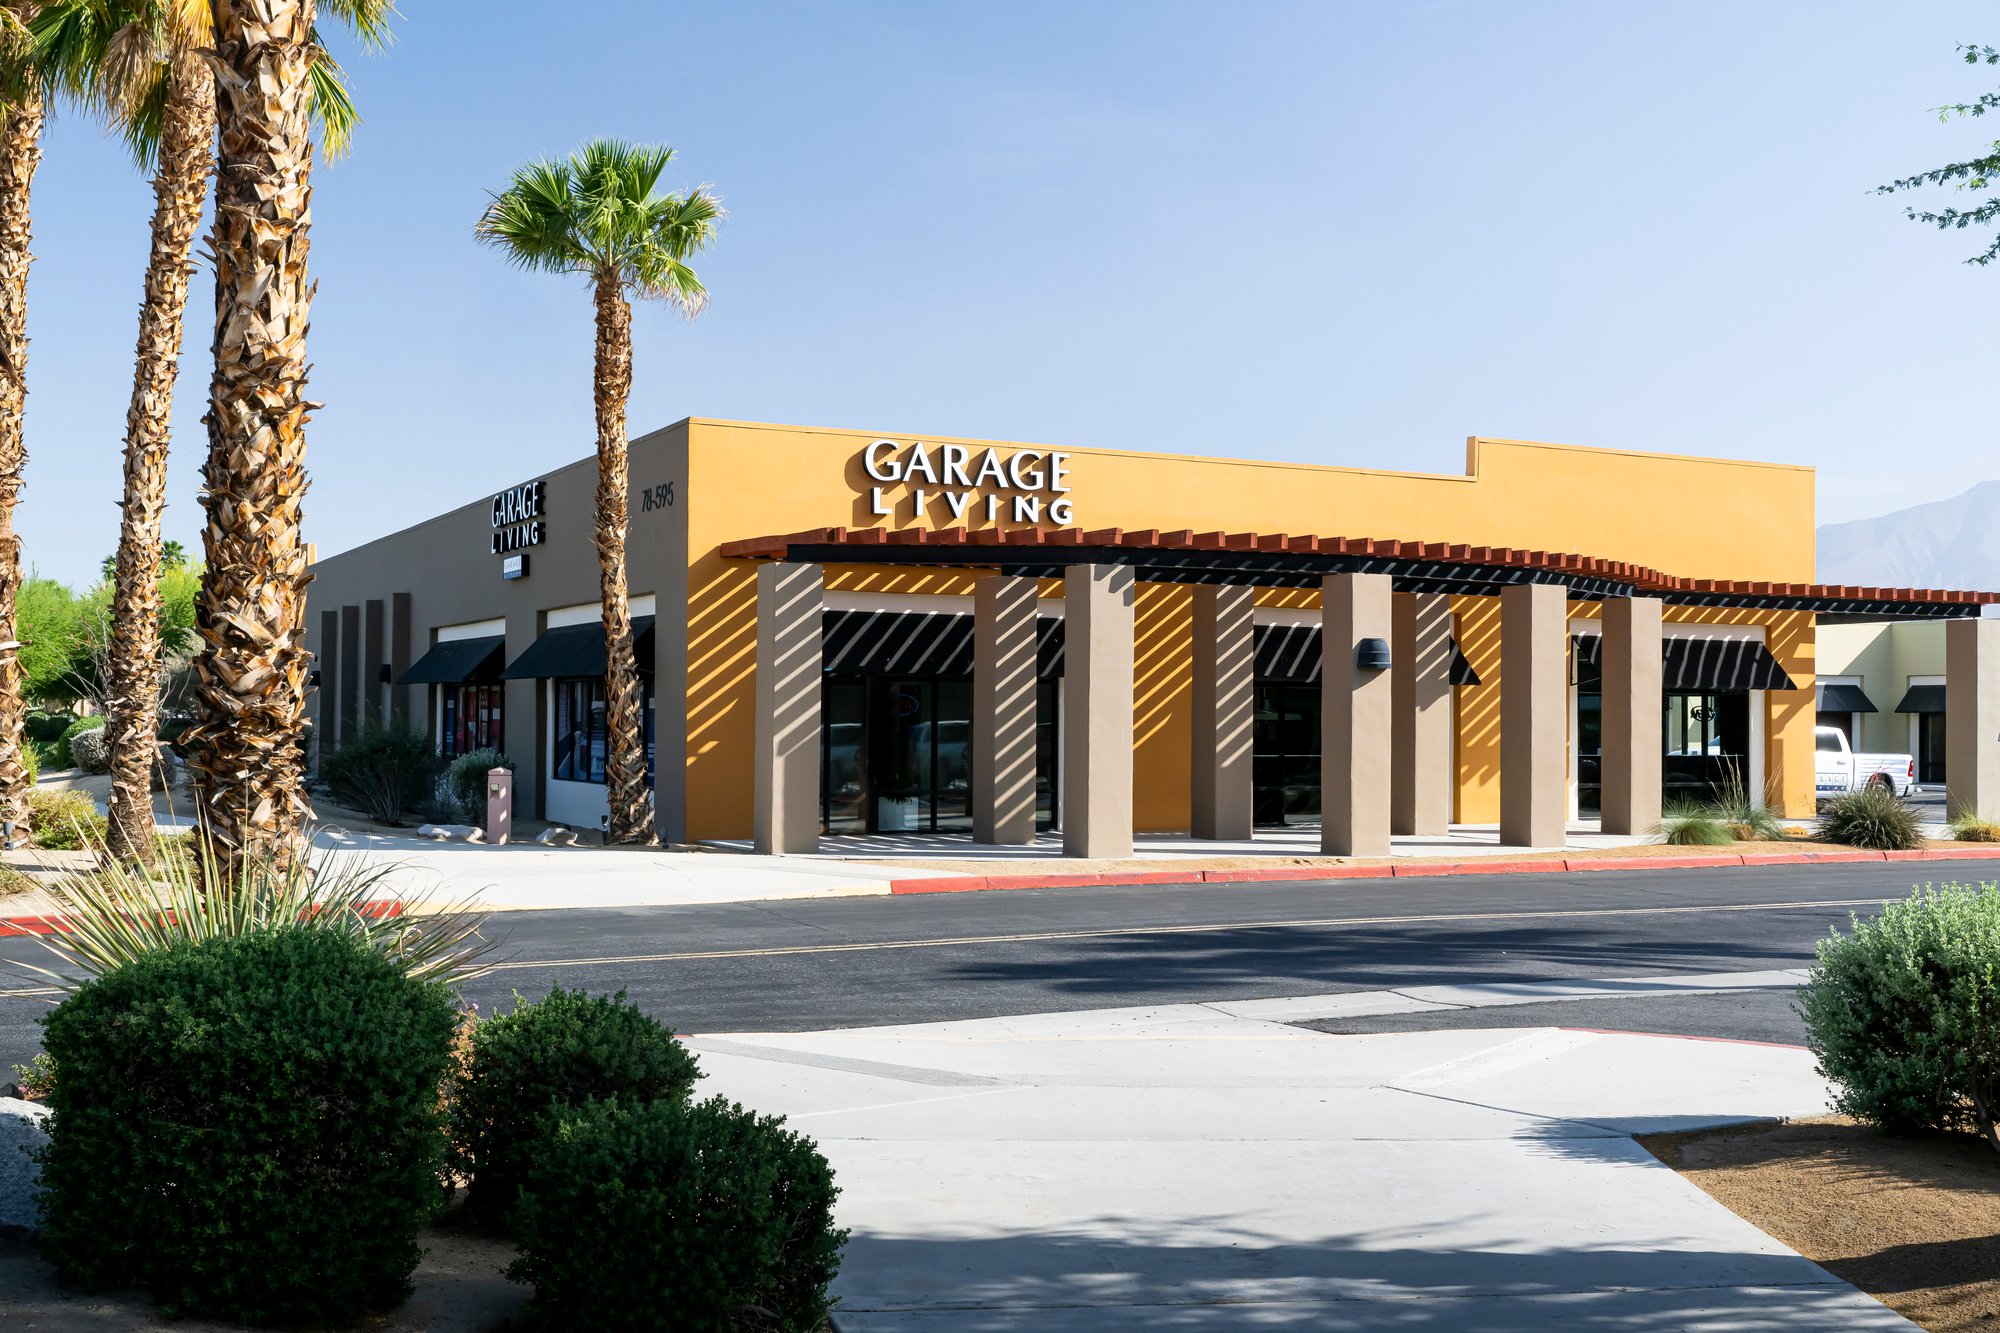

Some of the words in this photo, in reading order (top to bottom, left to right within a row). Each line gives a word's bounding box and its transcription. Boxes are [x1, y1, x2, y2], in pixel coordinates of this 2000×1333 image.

[864, 439, 1071, 493] GARAGE
[491, 481, 539, 528] GARAGE
[642, 481, 674, 513] 78-595
[871, 486, 1073, 525] LIVING
[490, 521, 539, 554] LIVING
